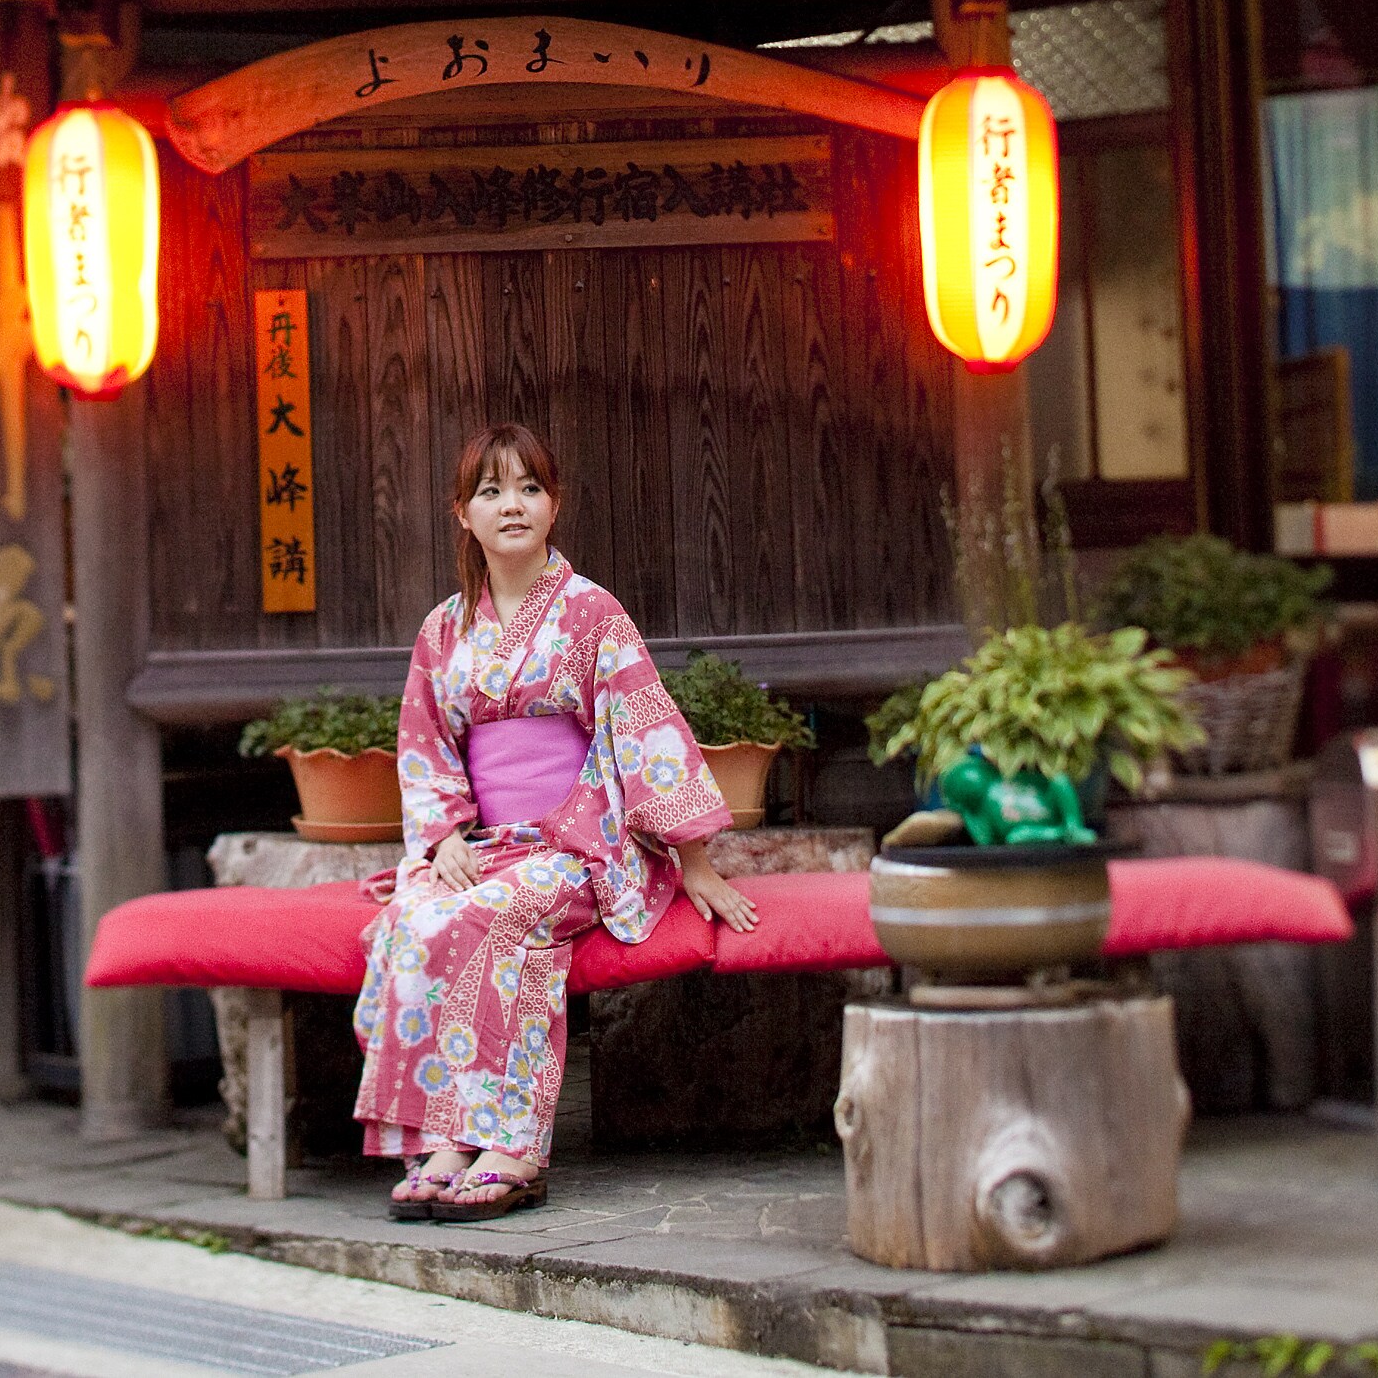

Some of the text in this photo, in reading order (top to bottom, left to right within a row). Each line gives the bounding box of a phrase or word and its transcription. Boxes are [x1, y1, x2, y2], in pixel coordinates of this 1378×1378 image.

[354, 27, 712, 98] よおまいり
[265, 311, 309, 584] 丹後大峰講
